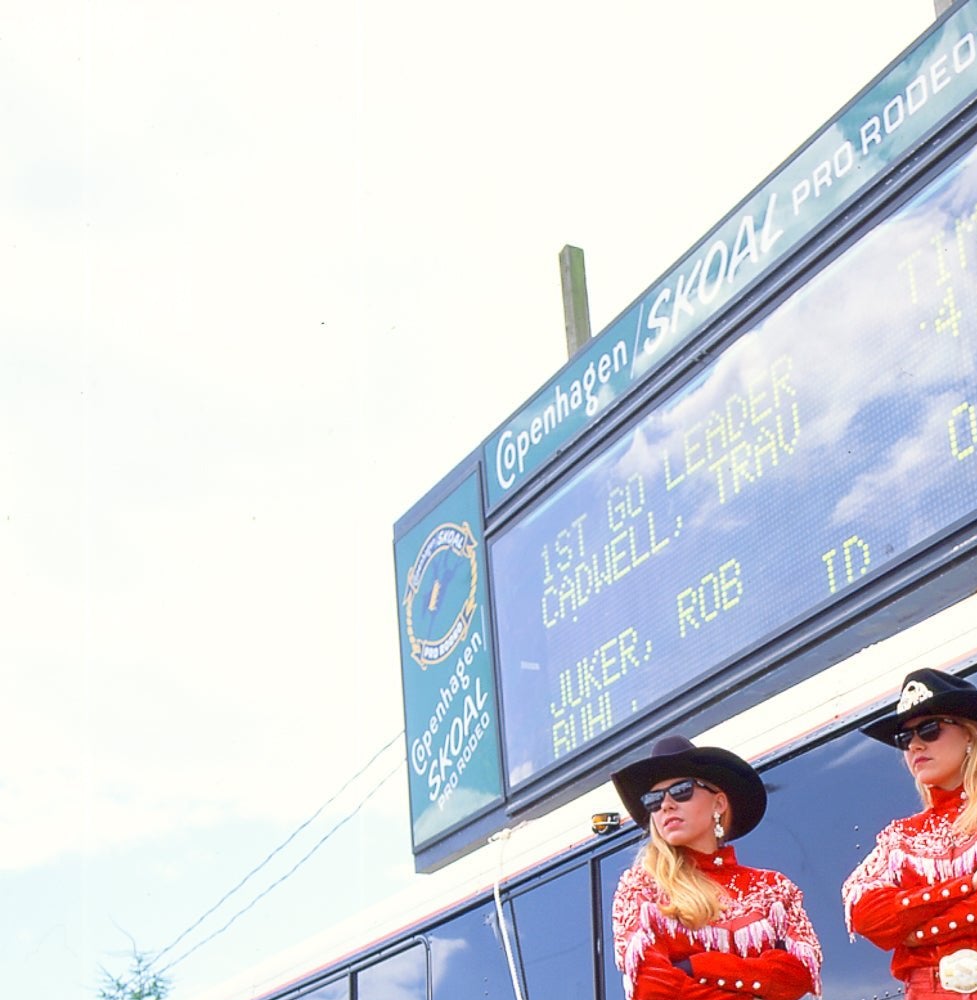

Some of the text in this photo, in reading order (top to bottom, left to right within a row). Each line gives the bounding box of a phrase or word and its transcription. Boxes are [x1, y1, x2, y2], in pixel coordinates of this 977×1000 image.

[792, 142, 853, 216] PRO
[861, 33, 977, 156] RODEO
[541, 513, 587, 584] 1ST
[607, 473, 646, 532] GO
[663, 354, 796, 491] LEADER
[677, 558, 743, 638] ROB
[412, 632, 482, 776] Copenhagen
[428, 676, 488, 801] SKOAL
[437, 711, 490, 811] PRO RODEO
